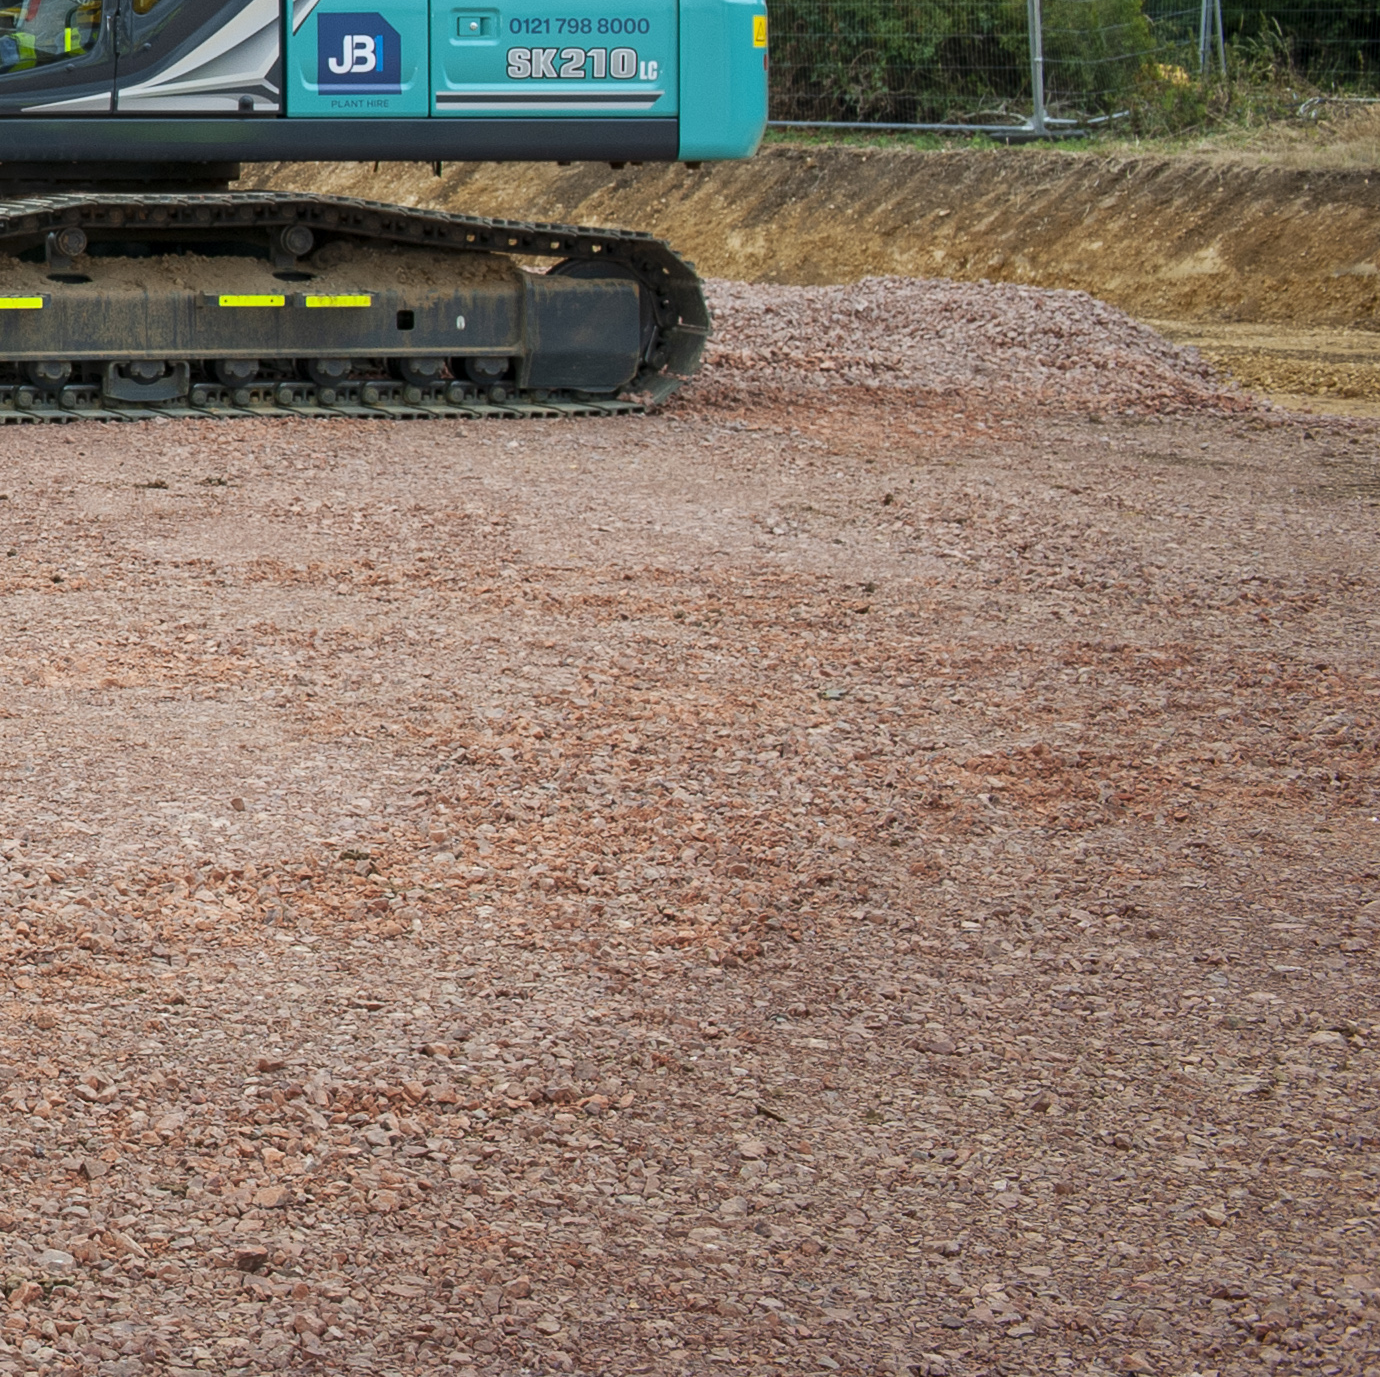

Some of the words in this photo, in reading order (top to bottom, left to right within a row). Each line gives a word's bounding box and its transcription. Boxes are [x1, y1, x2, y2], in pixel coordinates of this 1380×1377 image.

[509, 18, 550, 35] 0121
[557, 18, 593, 34] 798
[597, 18, 650, 34] 8000
[328, 34, 383, 74] JB1
[505, 46, 638, 80] SK210
[331, 100, 364, 108] PLANT
[366, 100, 389, 108] HIRE
